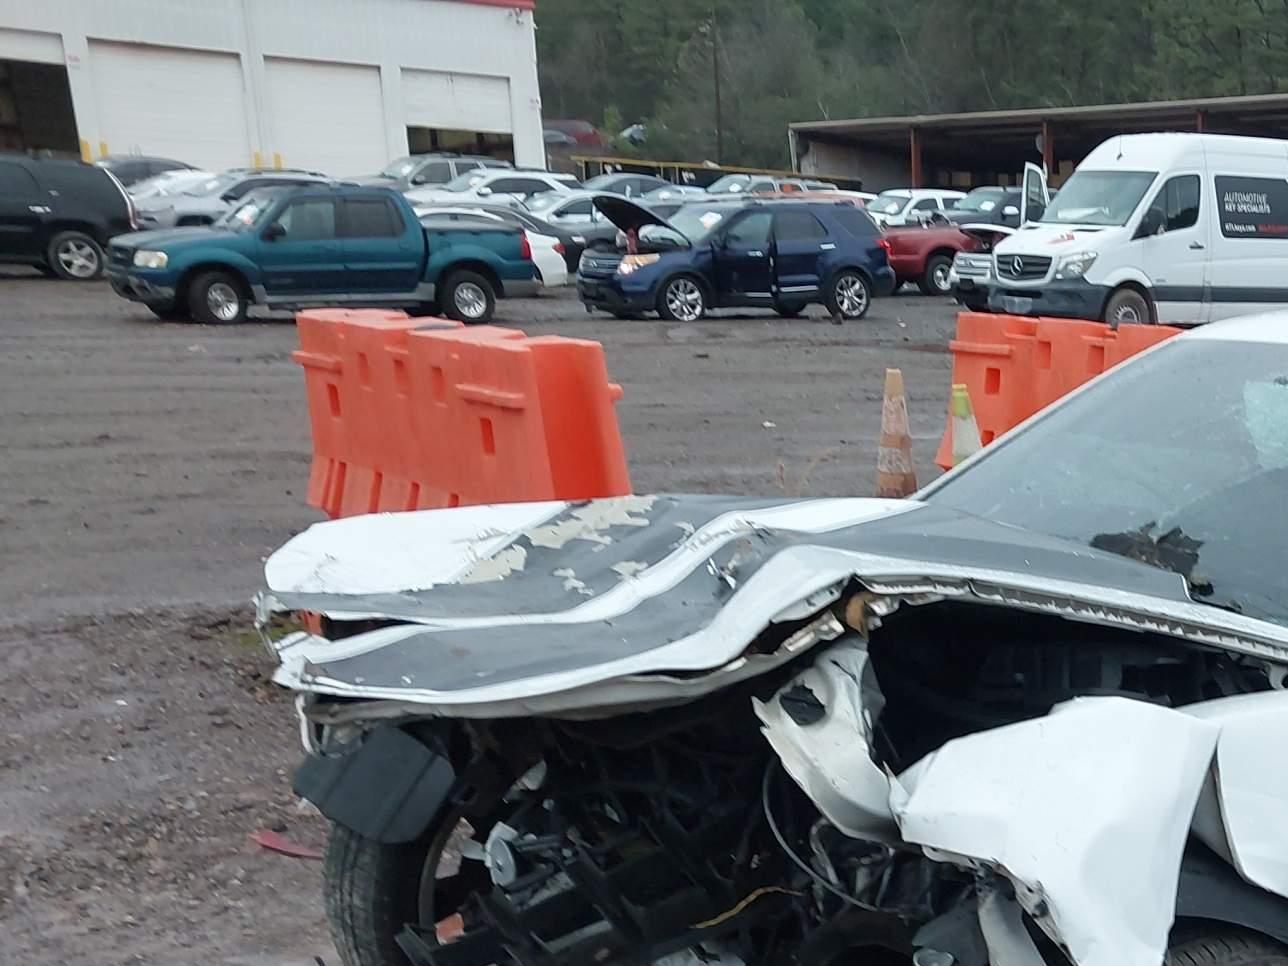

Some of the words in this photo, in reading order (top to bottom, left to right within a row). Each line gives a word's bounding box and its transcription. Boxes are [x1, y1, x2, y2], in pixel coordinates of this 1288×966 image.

[1224, 191, 1268, 204] AUTOMOTIVE
[1224, 202, 1236, 213] KEY
[1237, 203, 1271, 214] SPECIALISTS
